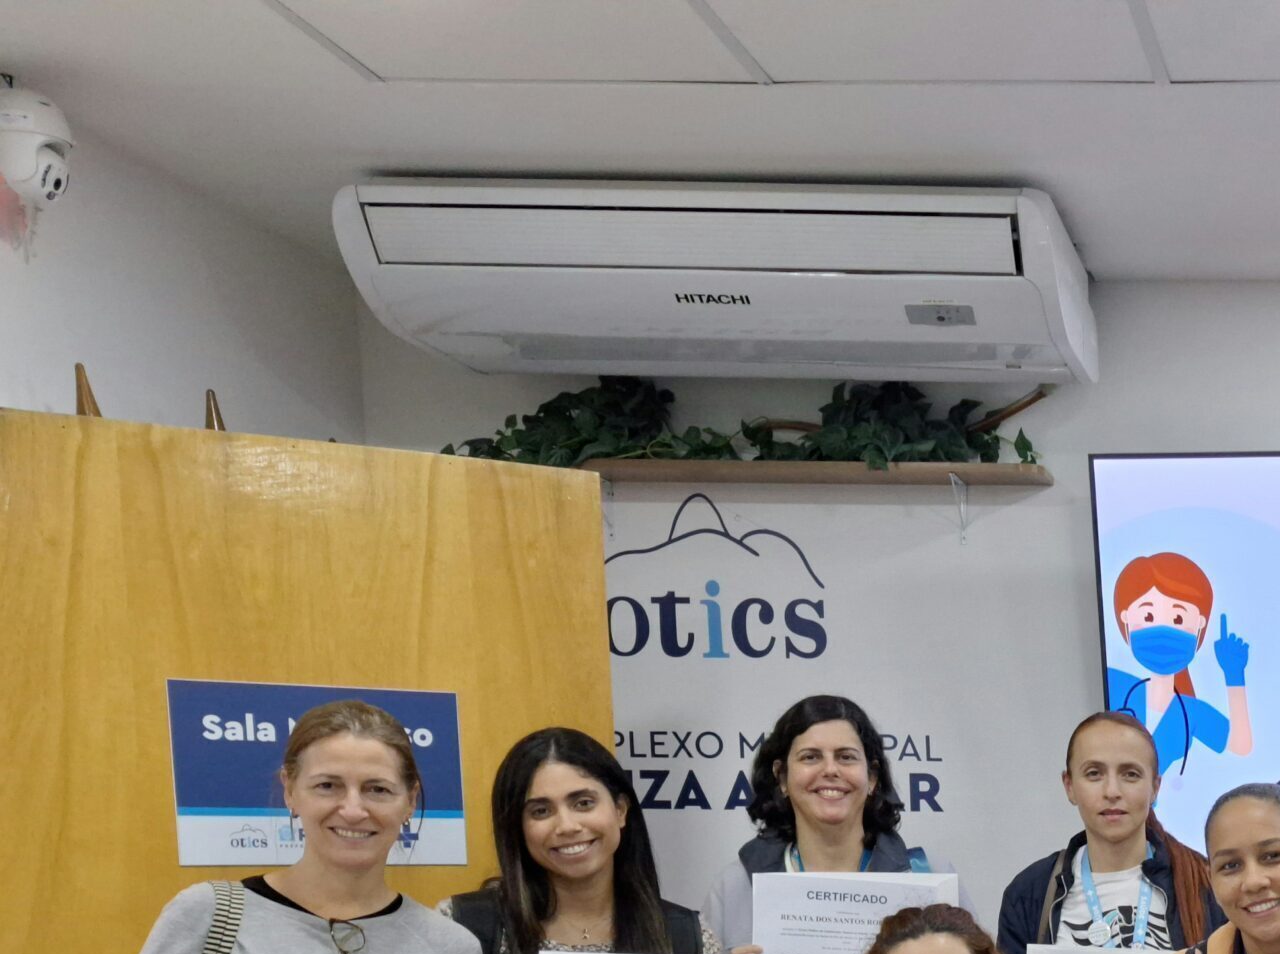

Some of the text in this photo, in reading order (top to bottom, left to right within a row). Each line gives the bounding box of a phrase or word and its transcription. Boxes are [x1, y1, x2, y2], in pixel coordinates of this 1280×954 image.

[674, 293, 751, 305] HITACHI
[607, 580, 828, 659] otics
[202, 713, 277, 742] Sala
[806, 890, 888, 905] CERTIFICADO
[780, 913, 814, 923] RENATA
[815, 915, 832, 924] DOS
[833, 916, 866, 925] SANTOS
